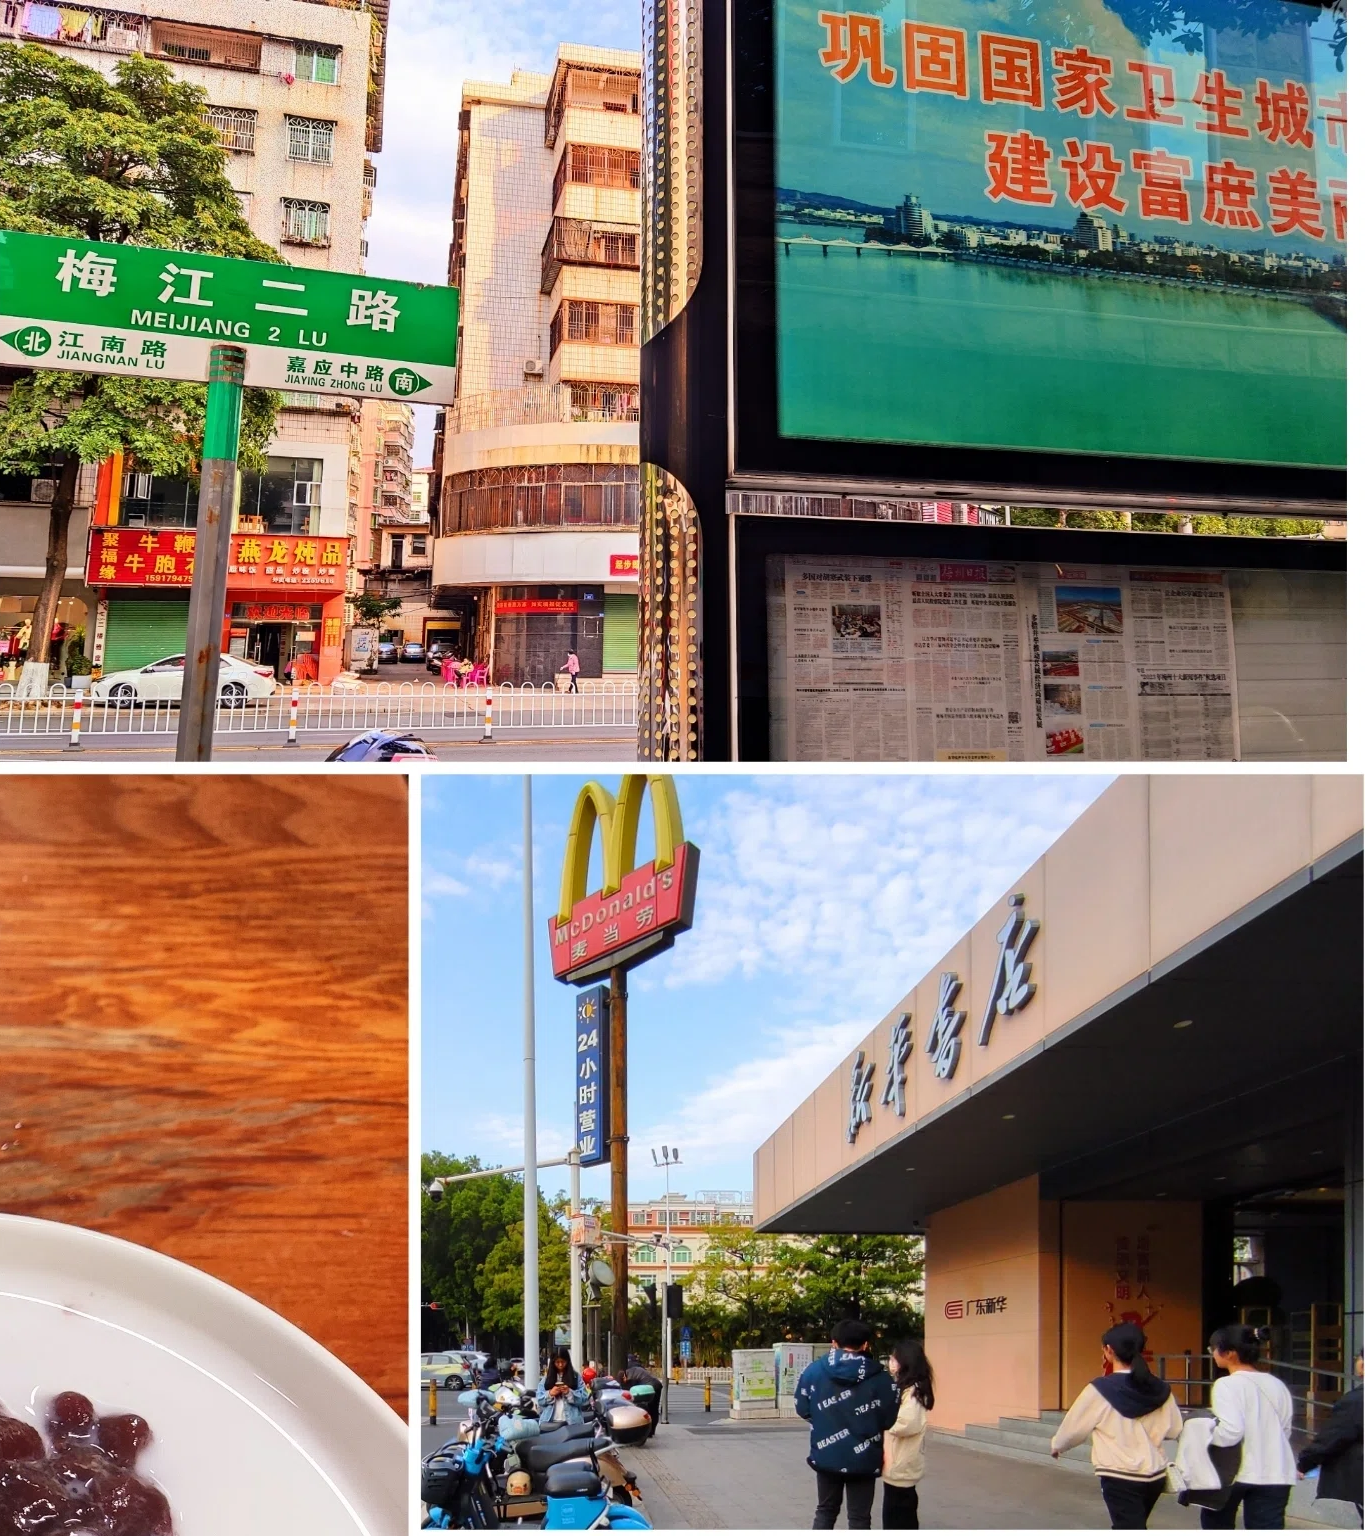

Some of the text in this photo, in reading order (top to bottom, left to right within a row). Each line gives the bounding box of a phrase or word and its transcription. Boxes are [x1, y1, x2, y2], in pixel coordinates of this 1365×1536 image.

[984, 128, 1347, 243] 建设富庶美
[55, 248, 401, 334] 梅江二路
[130, 308, 328, 348] MEIJIANG 2 LU
[24, 331, 46, 354] 北
[58, 330, 168, 358] 江南路
[57, 351, 166, 371] JIANGNAN LU
[286, 356, 385, 383] 嘉应中路
[284, 374, 384, 394] JIAYING ZHONG LU
[394, 372, 416, 392] 南
[99, 533, 119, 580] 聚福缘
[238, 539, 344, 566] 燕龙炖品
[246, 605, 311, 622] 欢迎光临
[554, 871, 674, 949] McDonald's
[571, 904, 655, 963] 麦当劳
[966, 1295, 1008, 1317] 广东新华
[816, 1428, 850, 1450] BEASTER
